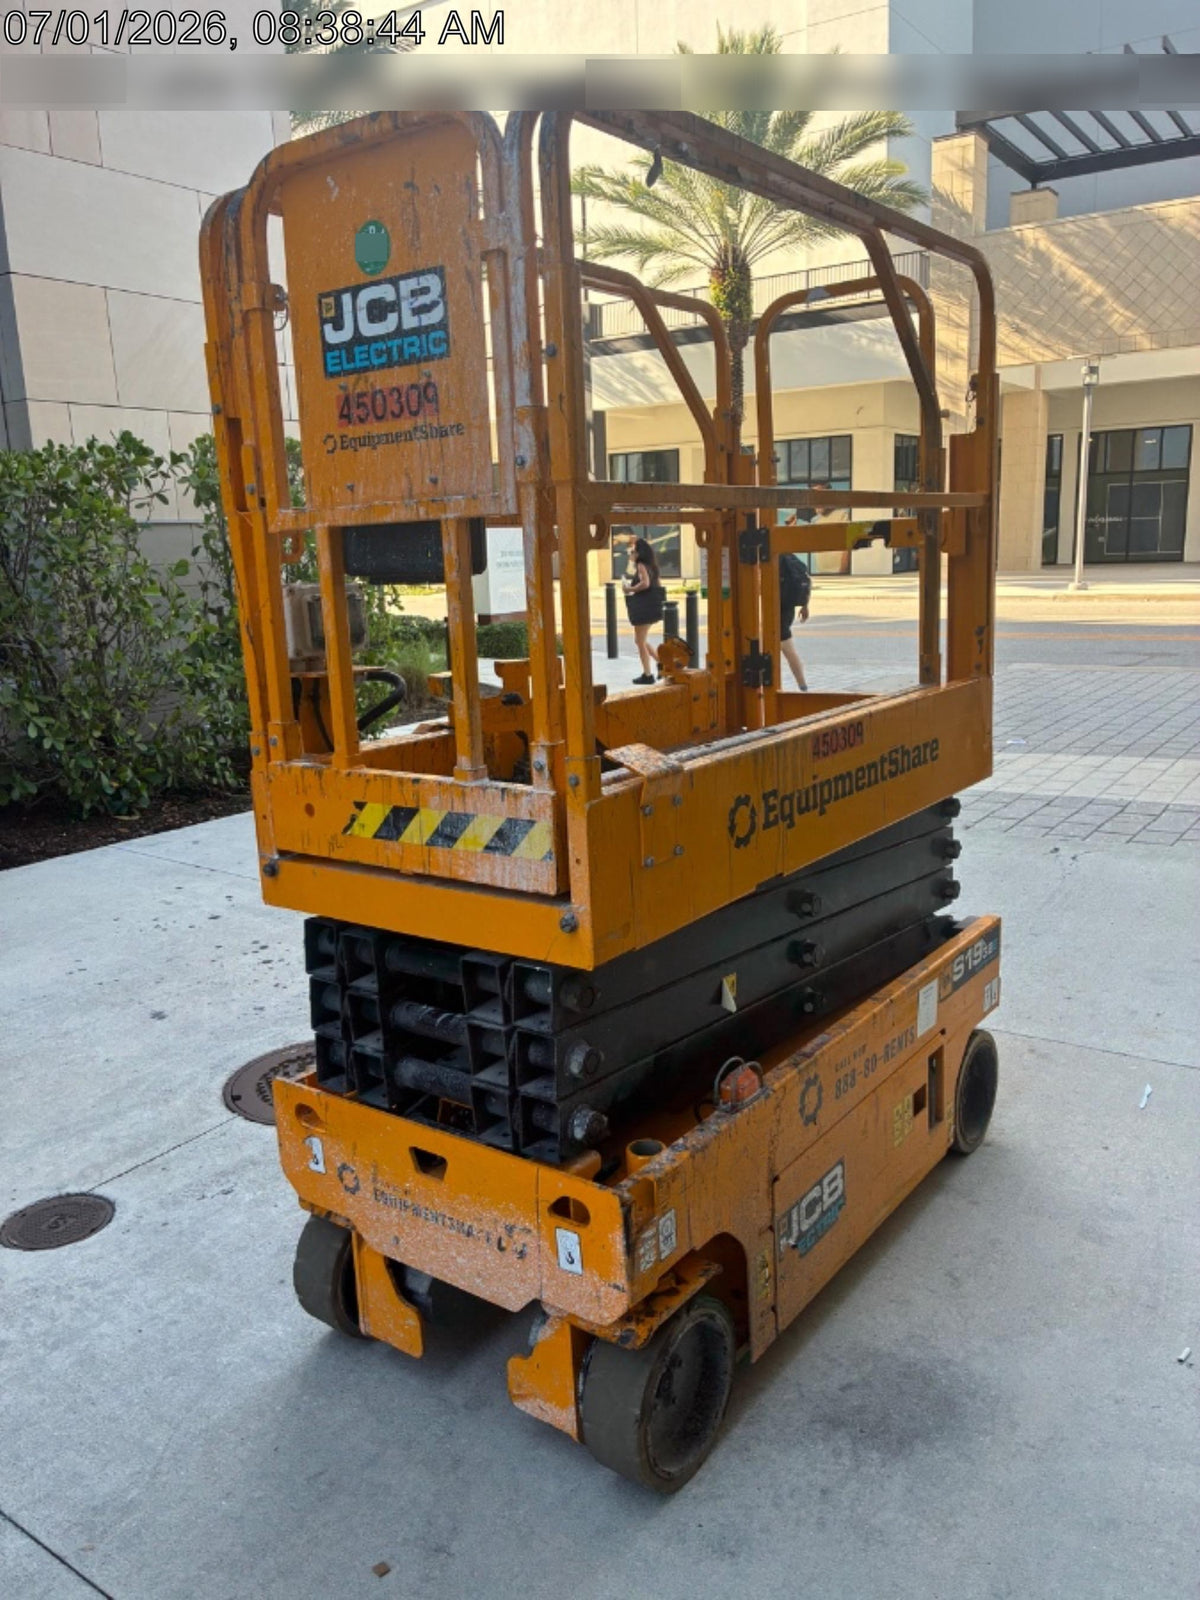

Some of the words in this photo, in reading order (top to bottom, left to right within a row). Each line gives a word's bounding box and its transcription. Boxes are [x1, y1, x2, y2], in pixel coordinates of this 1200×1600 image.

[323, 273, 445, 345] JCB
[325, 330, 447, 374] ELECTRIC
[338, 380, 440, 426] 450309
[340, 422, 465, 451] EquipmentShare
[812, 721, 864, 761] 450309
[762, 737, 940, 832] EquipmentShare
[780, 1164, 844, 1253] JCB
